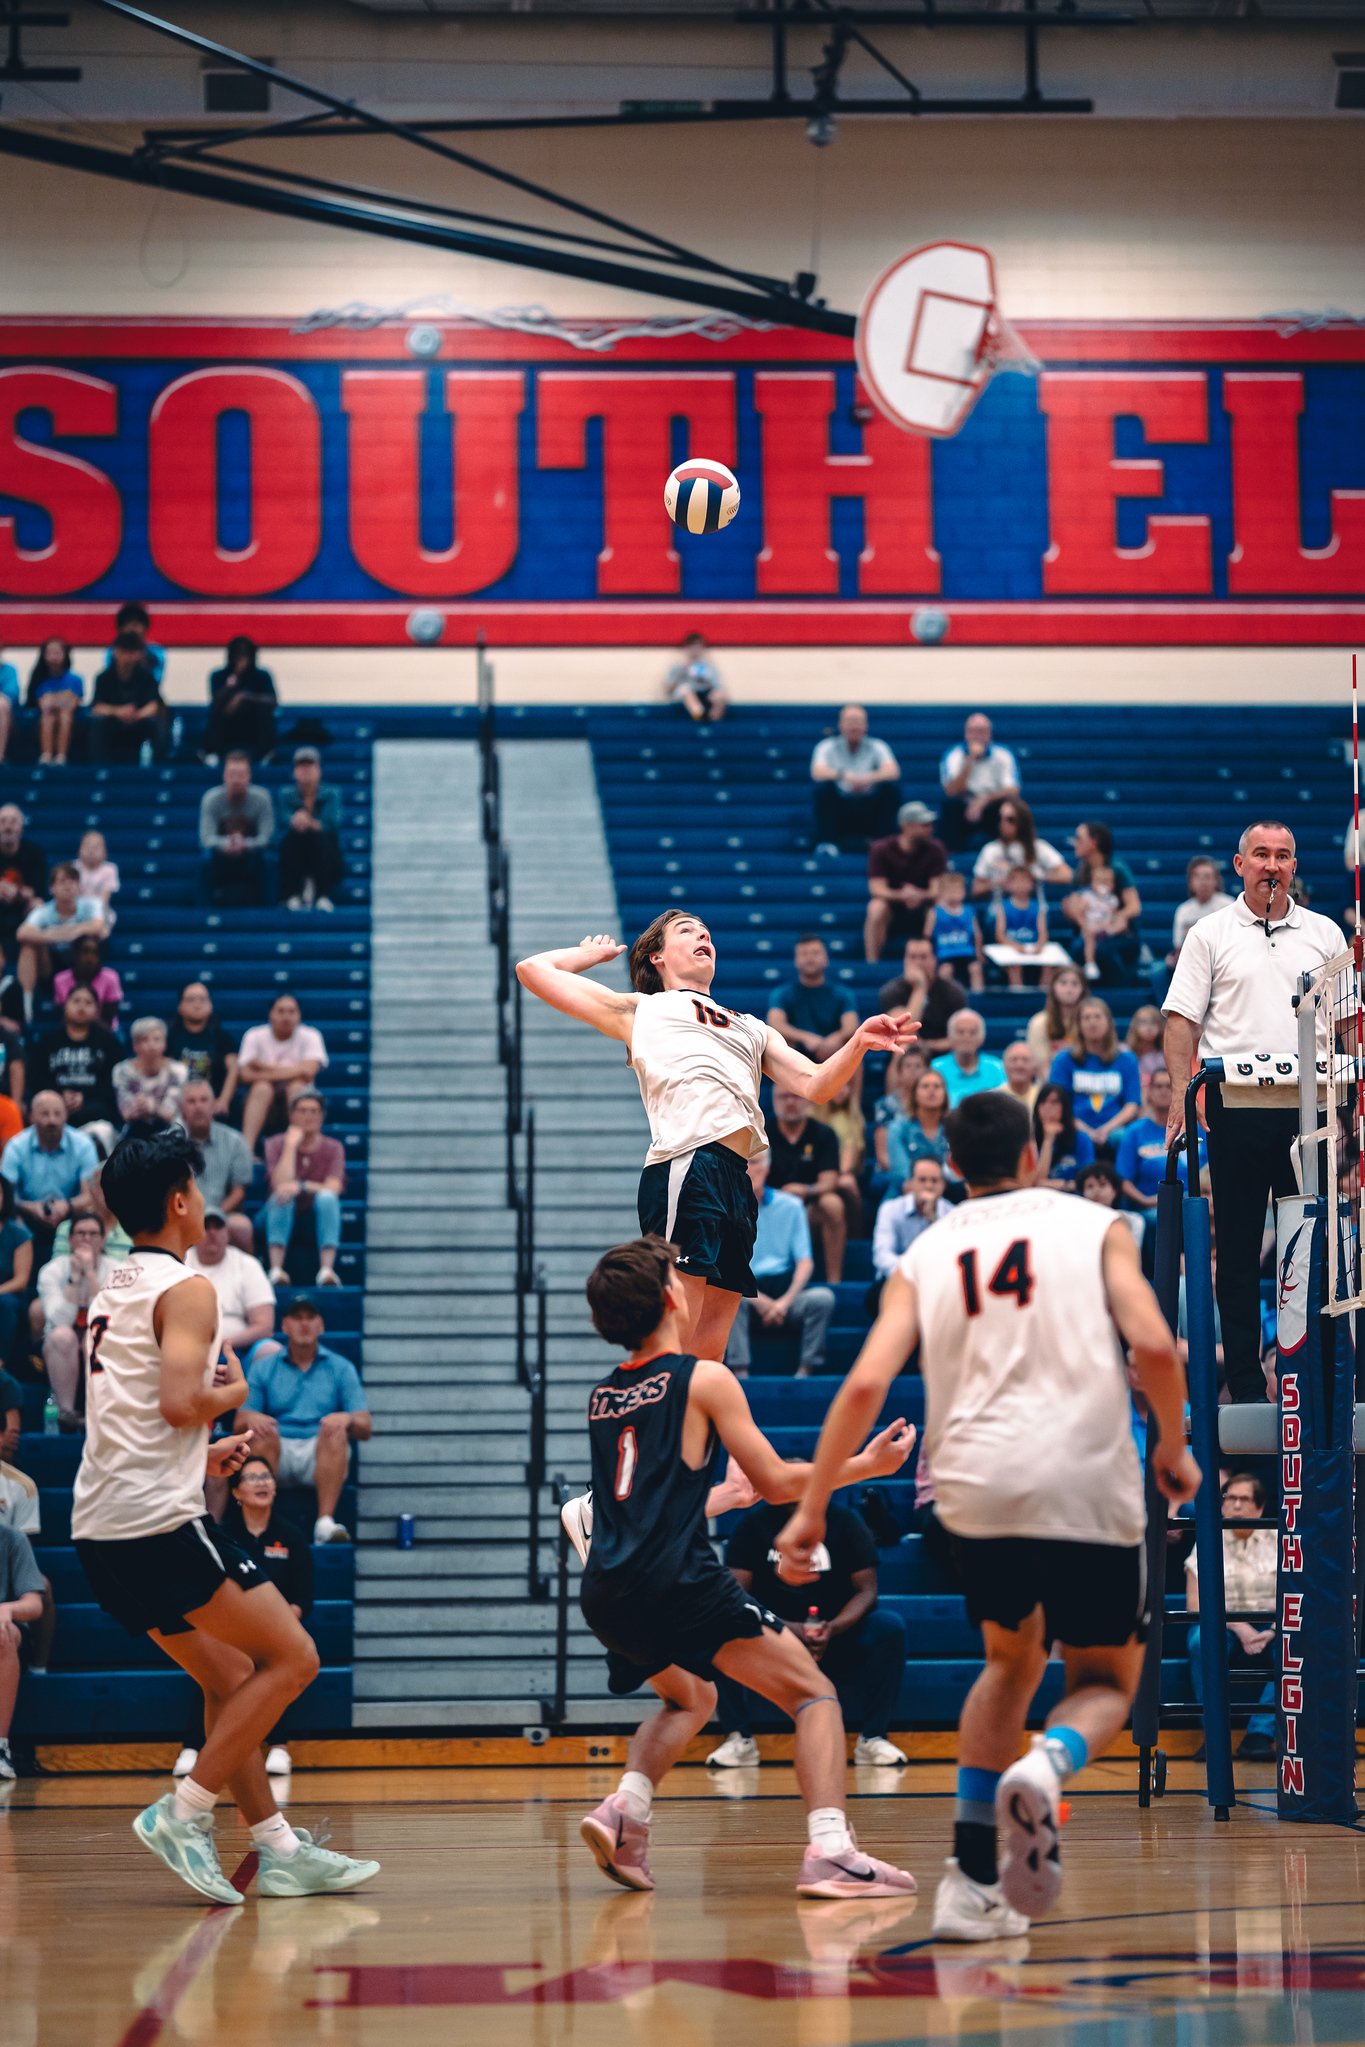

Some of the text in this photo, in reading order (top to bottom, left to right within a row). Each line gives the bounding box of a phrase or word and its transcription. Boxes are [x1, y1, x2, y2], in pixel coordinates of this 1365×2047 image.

[0, 365, 943, 596] SOUTH
[956, 1237, 1036, 1317] 14
[614, 1425, 638, 1501] 1
[1281, 1373, 1304, 1796] SOUTH ELGIN
